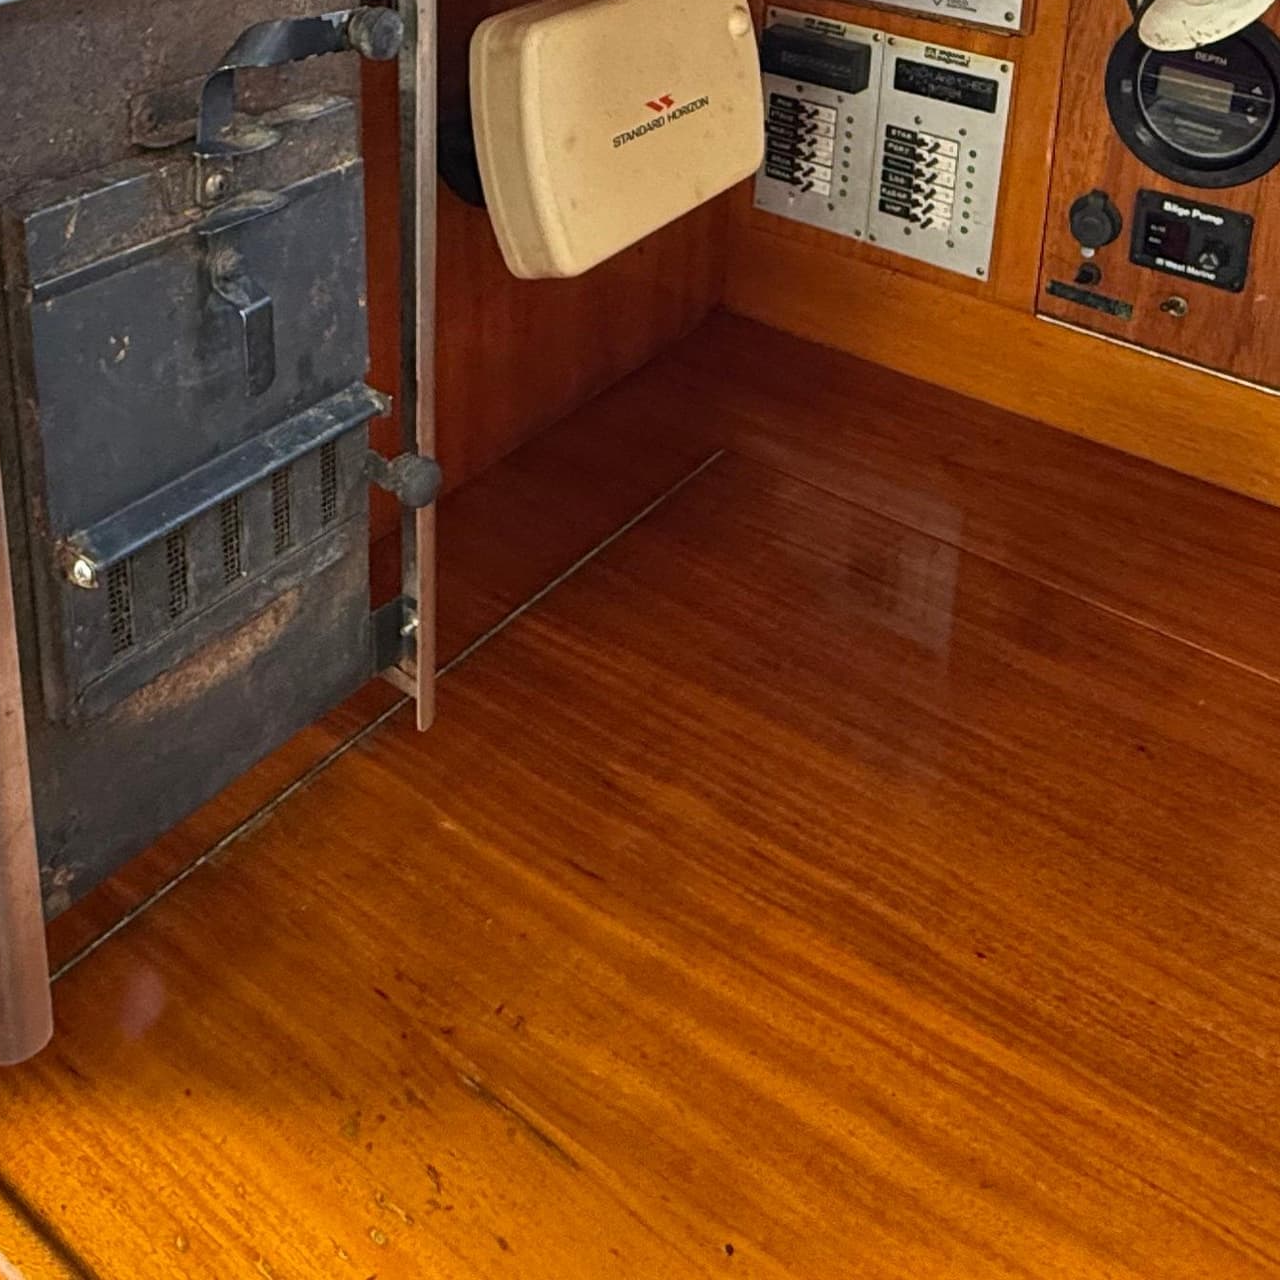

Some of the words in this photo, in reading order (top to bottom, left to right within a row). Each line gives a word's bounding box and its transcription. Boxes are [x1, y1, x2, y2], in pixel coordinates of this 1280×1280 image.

[1194, 50, 1228, 67] DEPTH
[612, 117, 666, 149] STANDARD
[668, 95, 710, 123] HORIZON
[1163, 200, 1191, 217] Bilge
[1191, 207, 1224, 226] Pump
[1165, 260, 1186, 273] West
[1186, 265, 1217, 281] Marine
